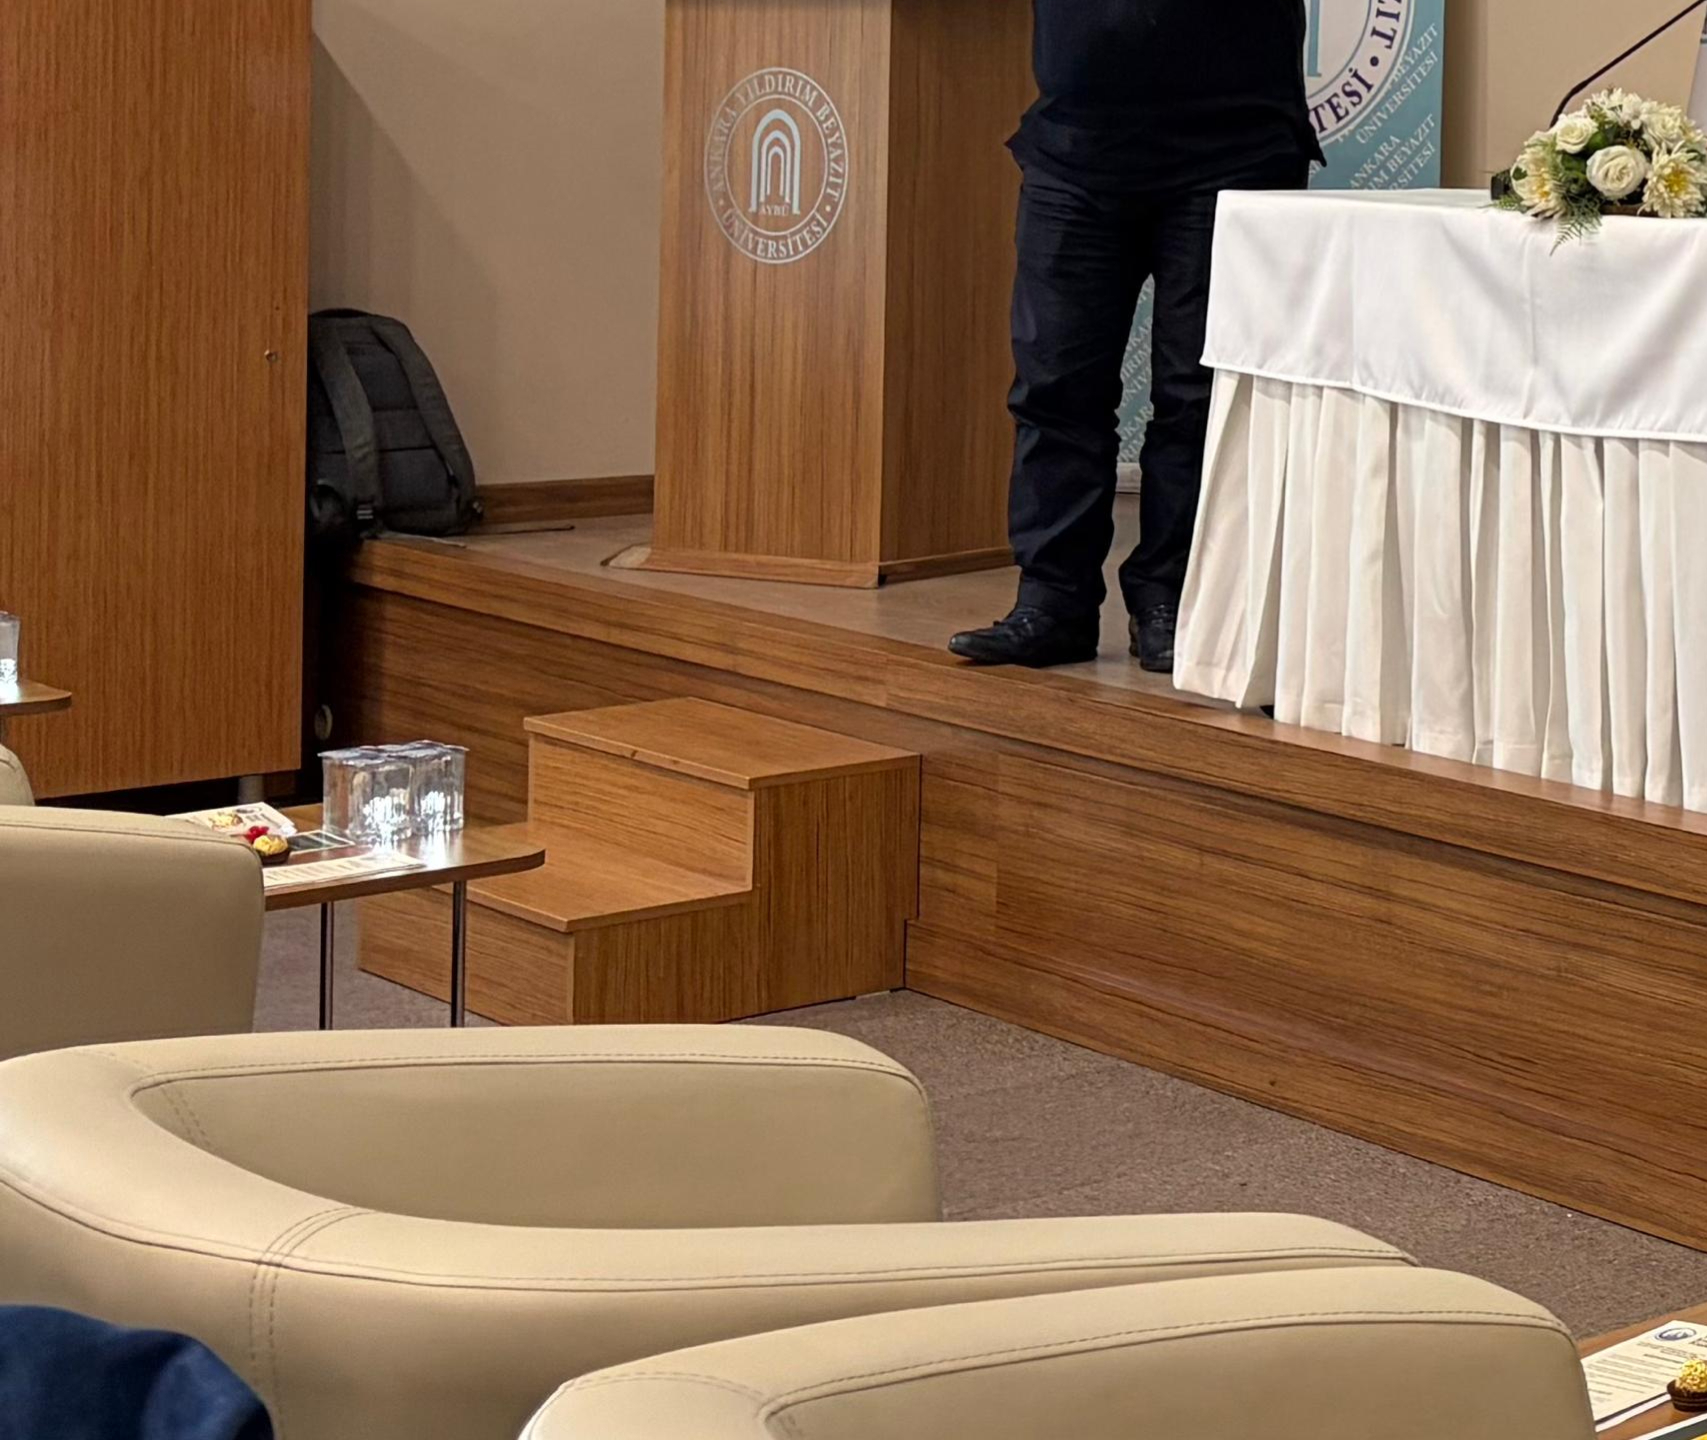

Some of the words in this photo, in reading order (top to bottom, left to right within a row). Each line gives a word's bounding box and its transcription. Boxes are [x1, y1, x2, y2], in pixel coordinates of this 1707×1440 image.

[735, 74, 819, 108] YILDIRIM
[816, 102, 845, 202] BEYAZIT
[1387, 113, 1435, 172] BEYAZIT
[721, 207, 829, 259] ÜNİVERSİTESİ
